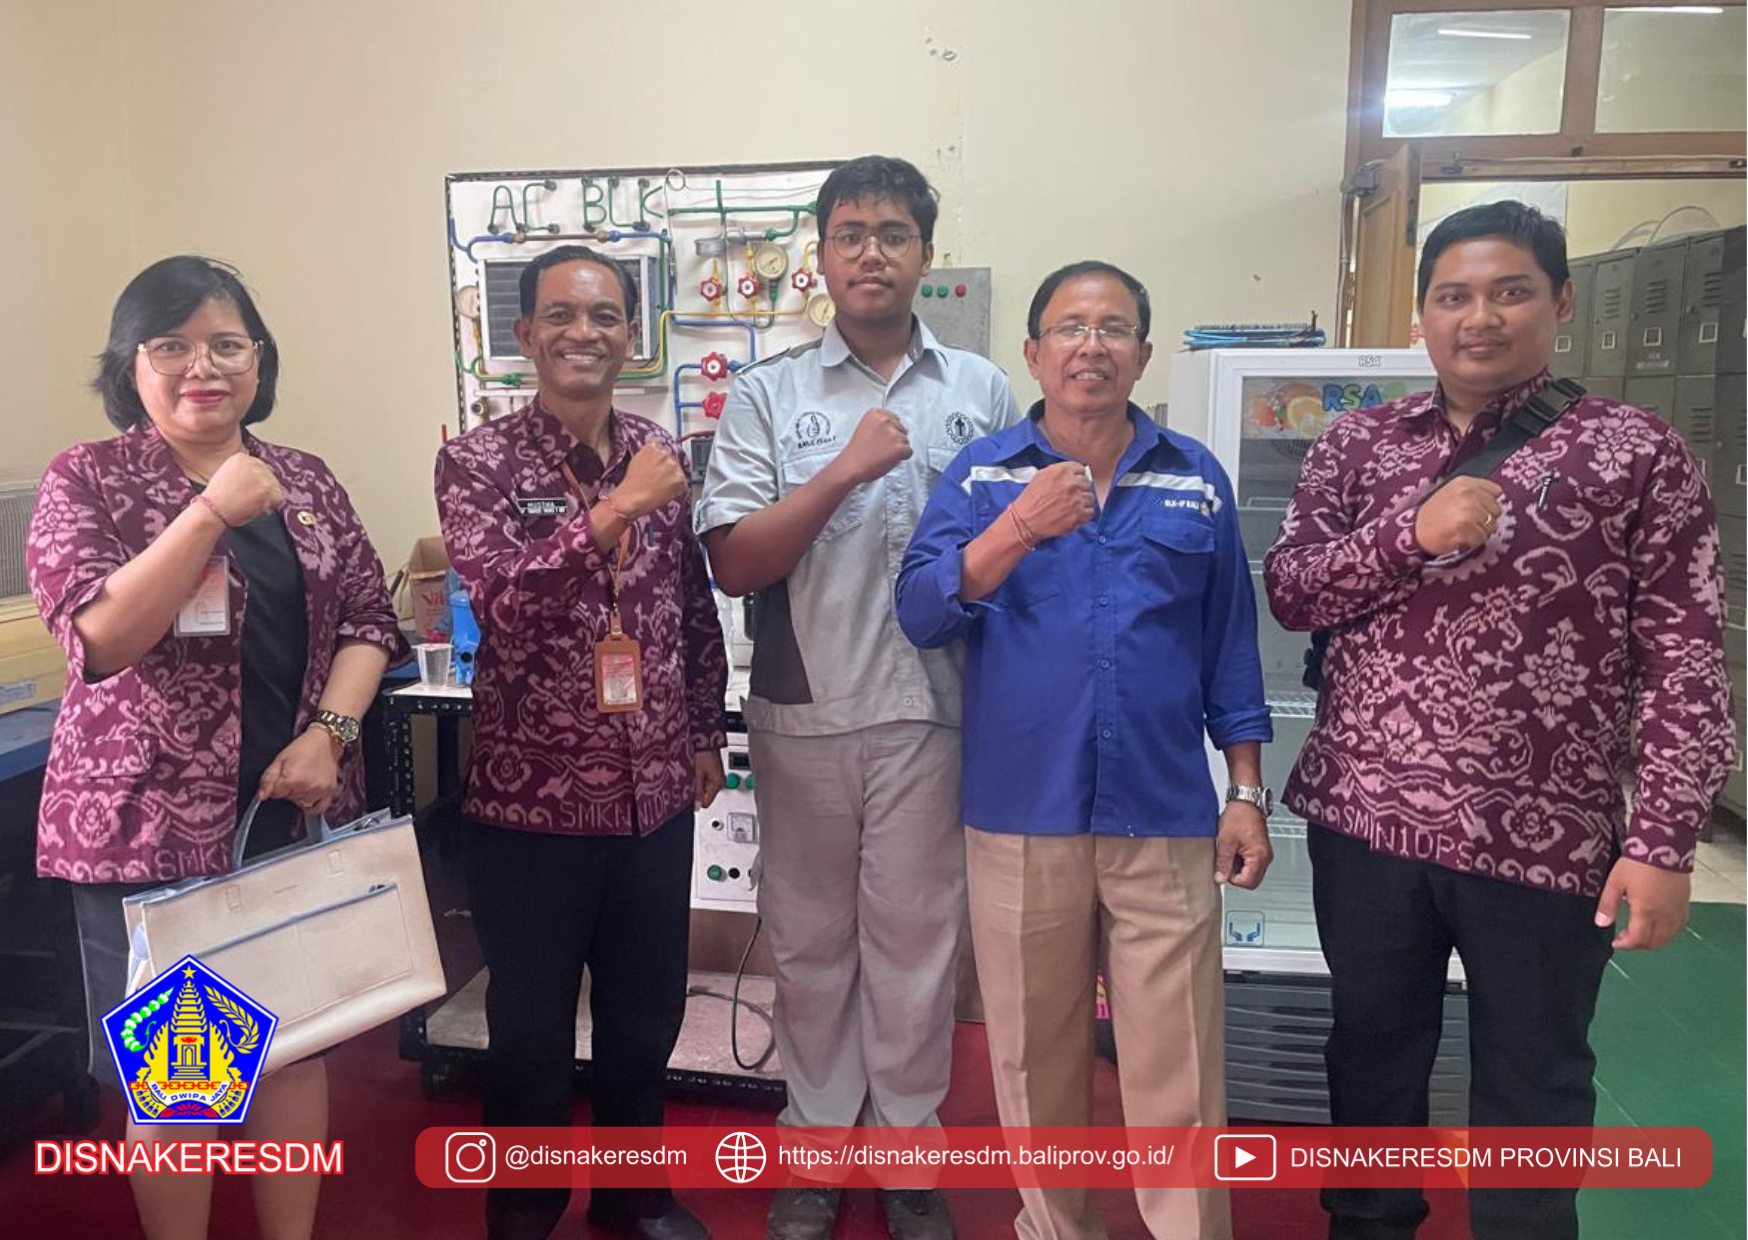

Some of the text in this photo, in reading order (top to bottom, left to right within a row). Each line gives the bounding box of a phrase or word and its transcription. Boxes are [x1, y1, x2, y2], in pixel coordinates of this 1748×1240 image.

[488, 176, 665, 234] AC BLK
[1358, 354, 1381, 368] RSA
[1323, 383, 1382, 413] RSA
